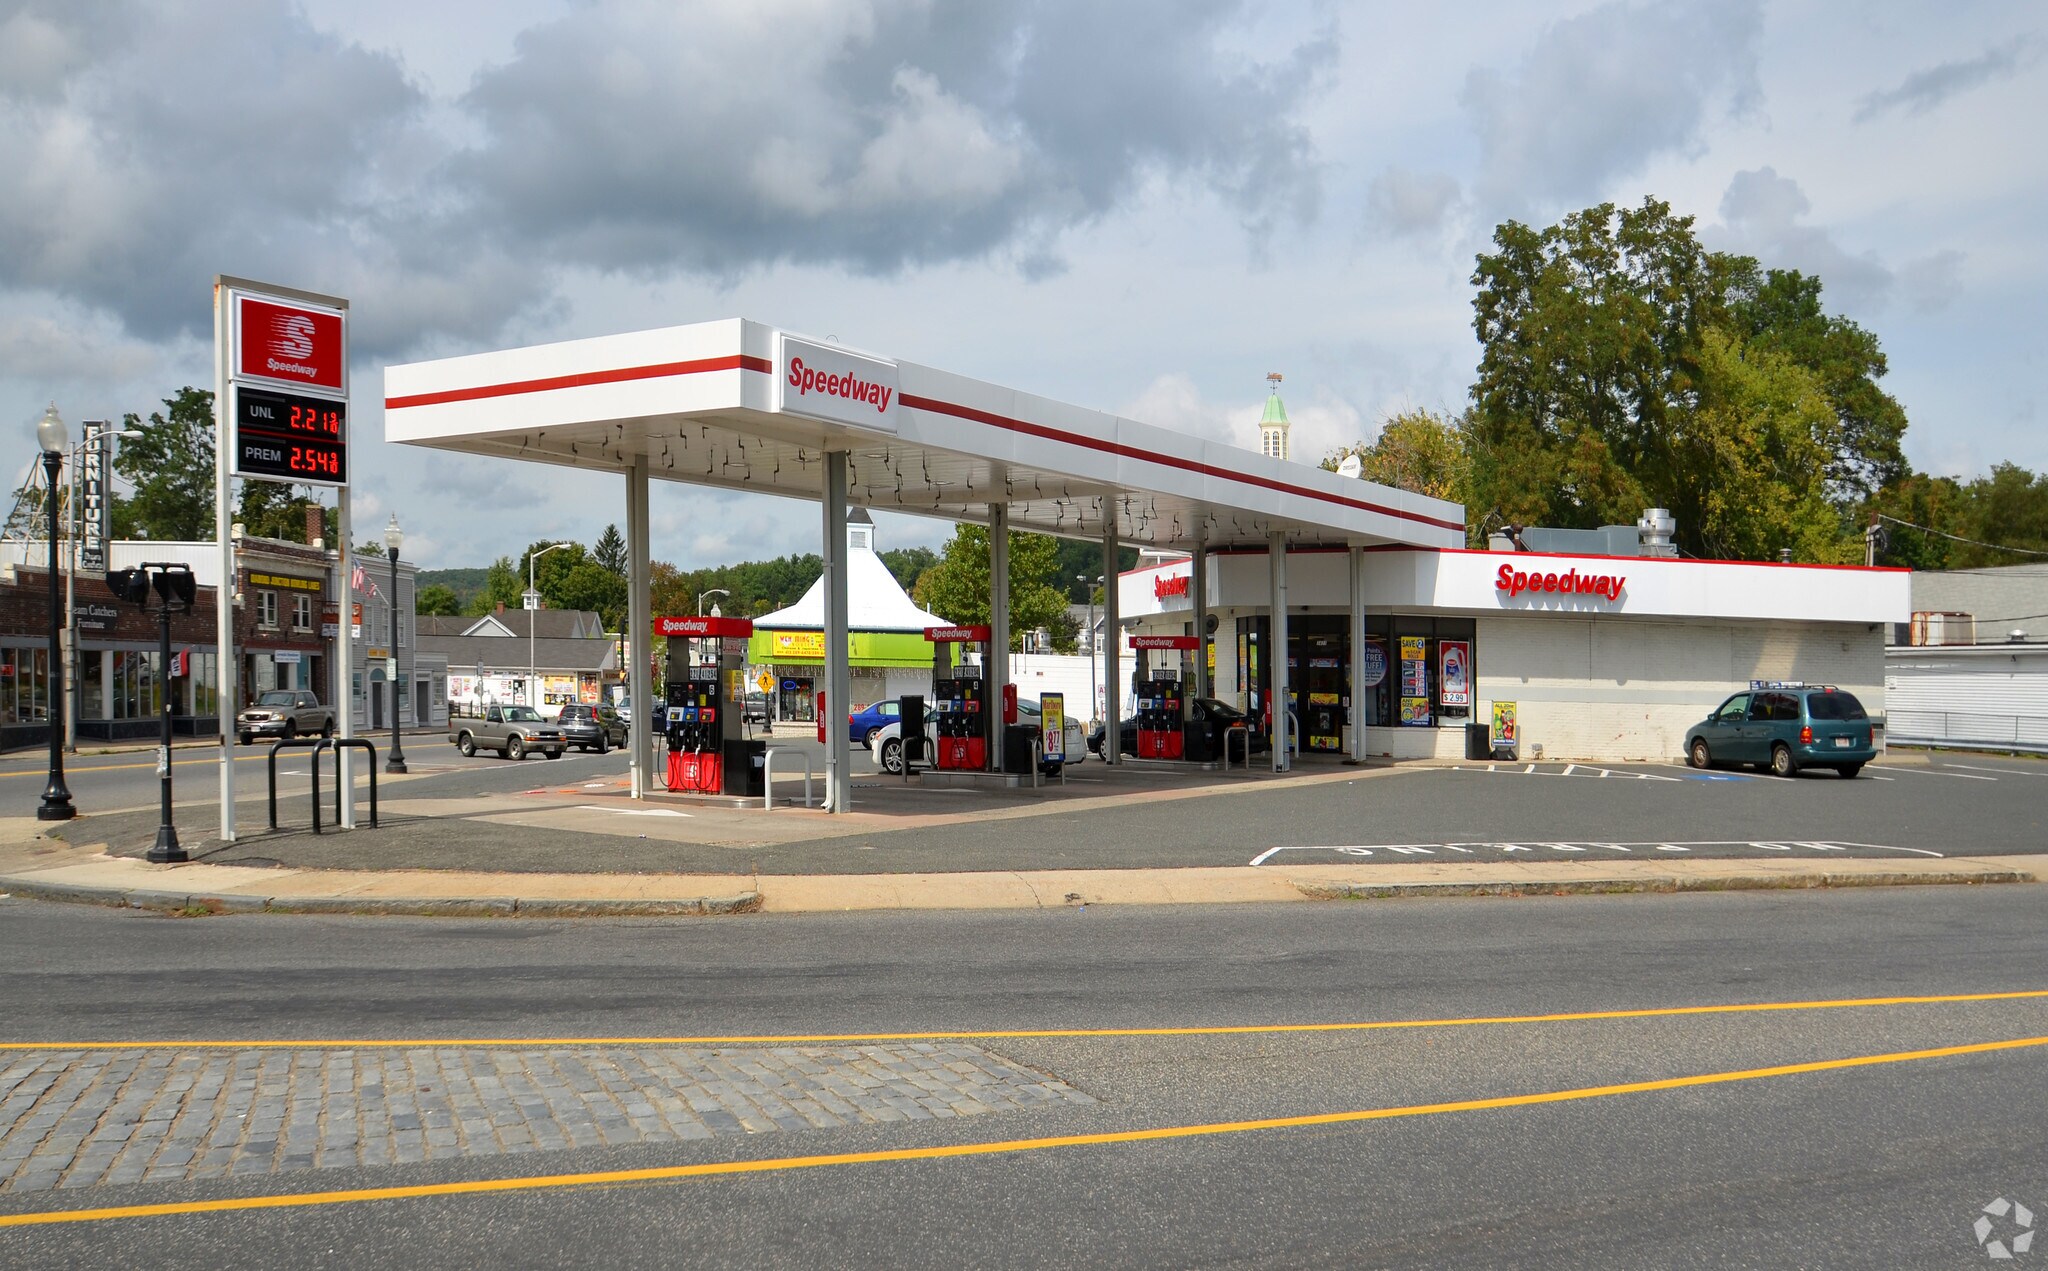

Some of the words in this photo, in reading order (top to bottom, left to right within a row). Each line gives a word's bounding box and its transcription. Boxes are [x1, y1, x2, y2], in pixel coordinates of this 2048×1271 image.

[266, 357, 318, 378] Speedway
[788, 357, 893, 413] Speedway
[249, 405, 275, 420] UNL
[245, 446, 282, 462] PREM
[85, 426, 101, 549] FURNITURE
[1154, 572, 1190, 602] Speedway
[1495, 563, 1627, 601] Speedway
[662, 619, 708, 633] Speedway
[931, 628, 973, 639] Speedway
[1135, 637, 1175, 648] Speedway
[1402, 639, 1416, 648] SAVE
[1366, 653, 1383, 661] FREE
[709, 685, 715, 695] 6
[1174, 683, 1179, 691] 2
[1444, 693, 1449, 701] $
[1449, 693, 1464, 702] 2.99
